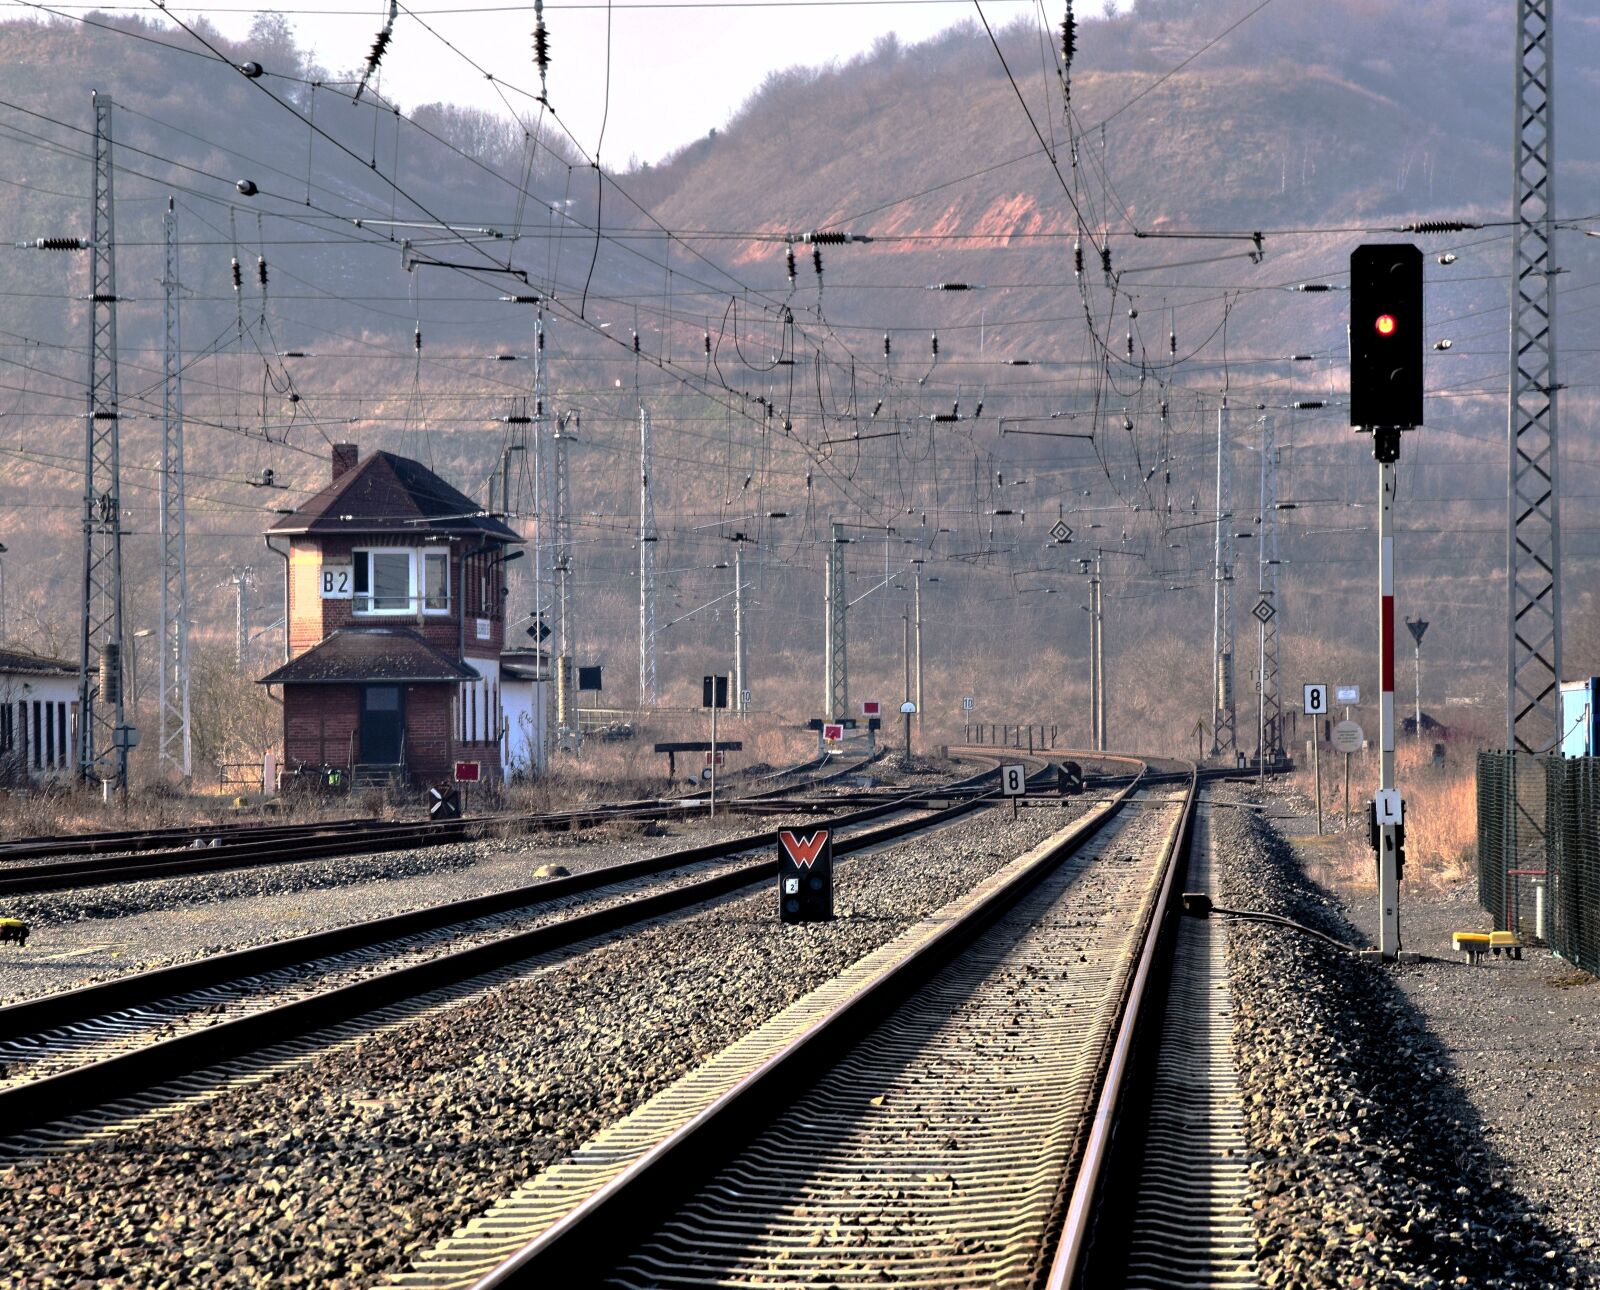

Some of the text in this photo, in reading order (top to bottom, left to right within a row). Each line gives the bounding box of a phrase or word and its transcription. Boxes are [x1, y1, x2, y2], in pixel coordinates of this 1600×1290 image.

[1310, 688, 1321, 710] 8
[1009, 769, 1019, 791] 8
[1384, 798, 1394, 817] L
[779, 830, 829, 870] W
[790, 883, 796, 892] 2
